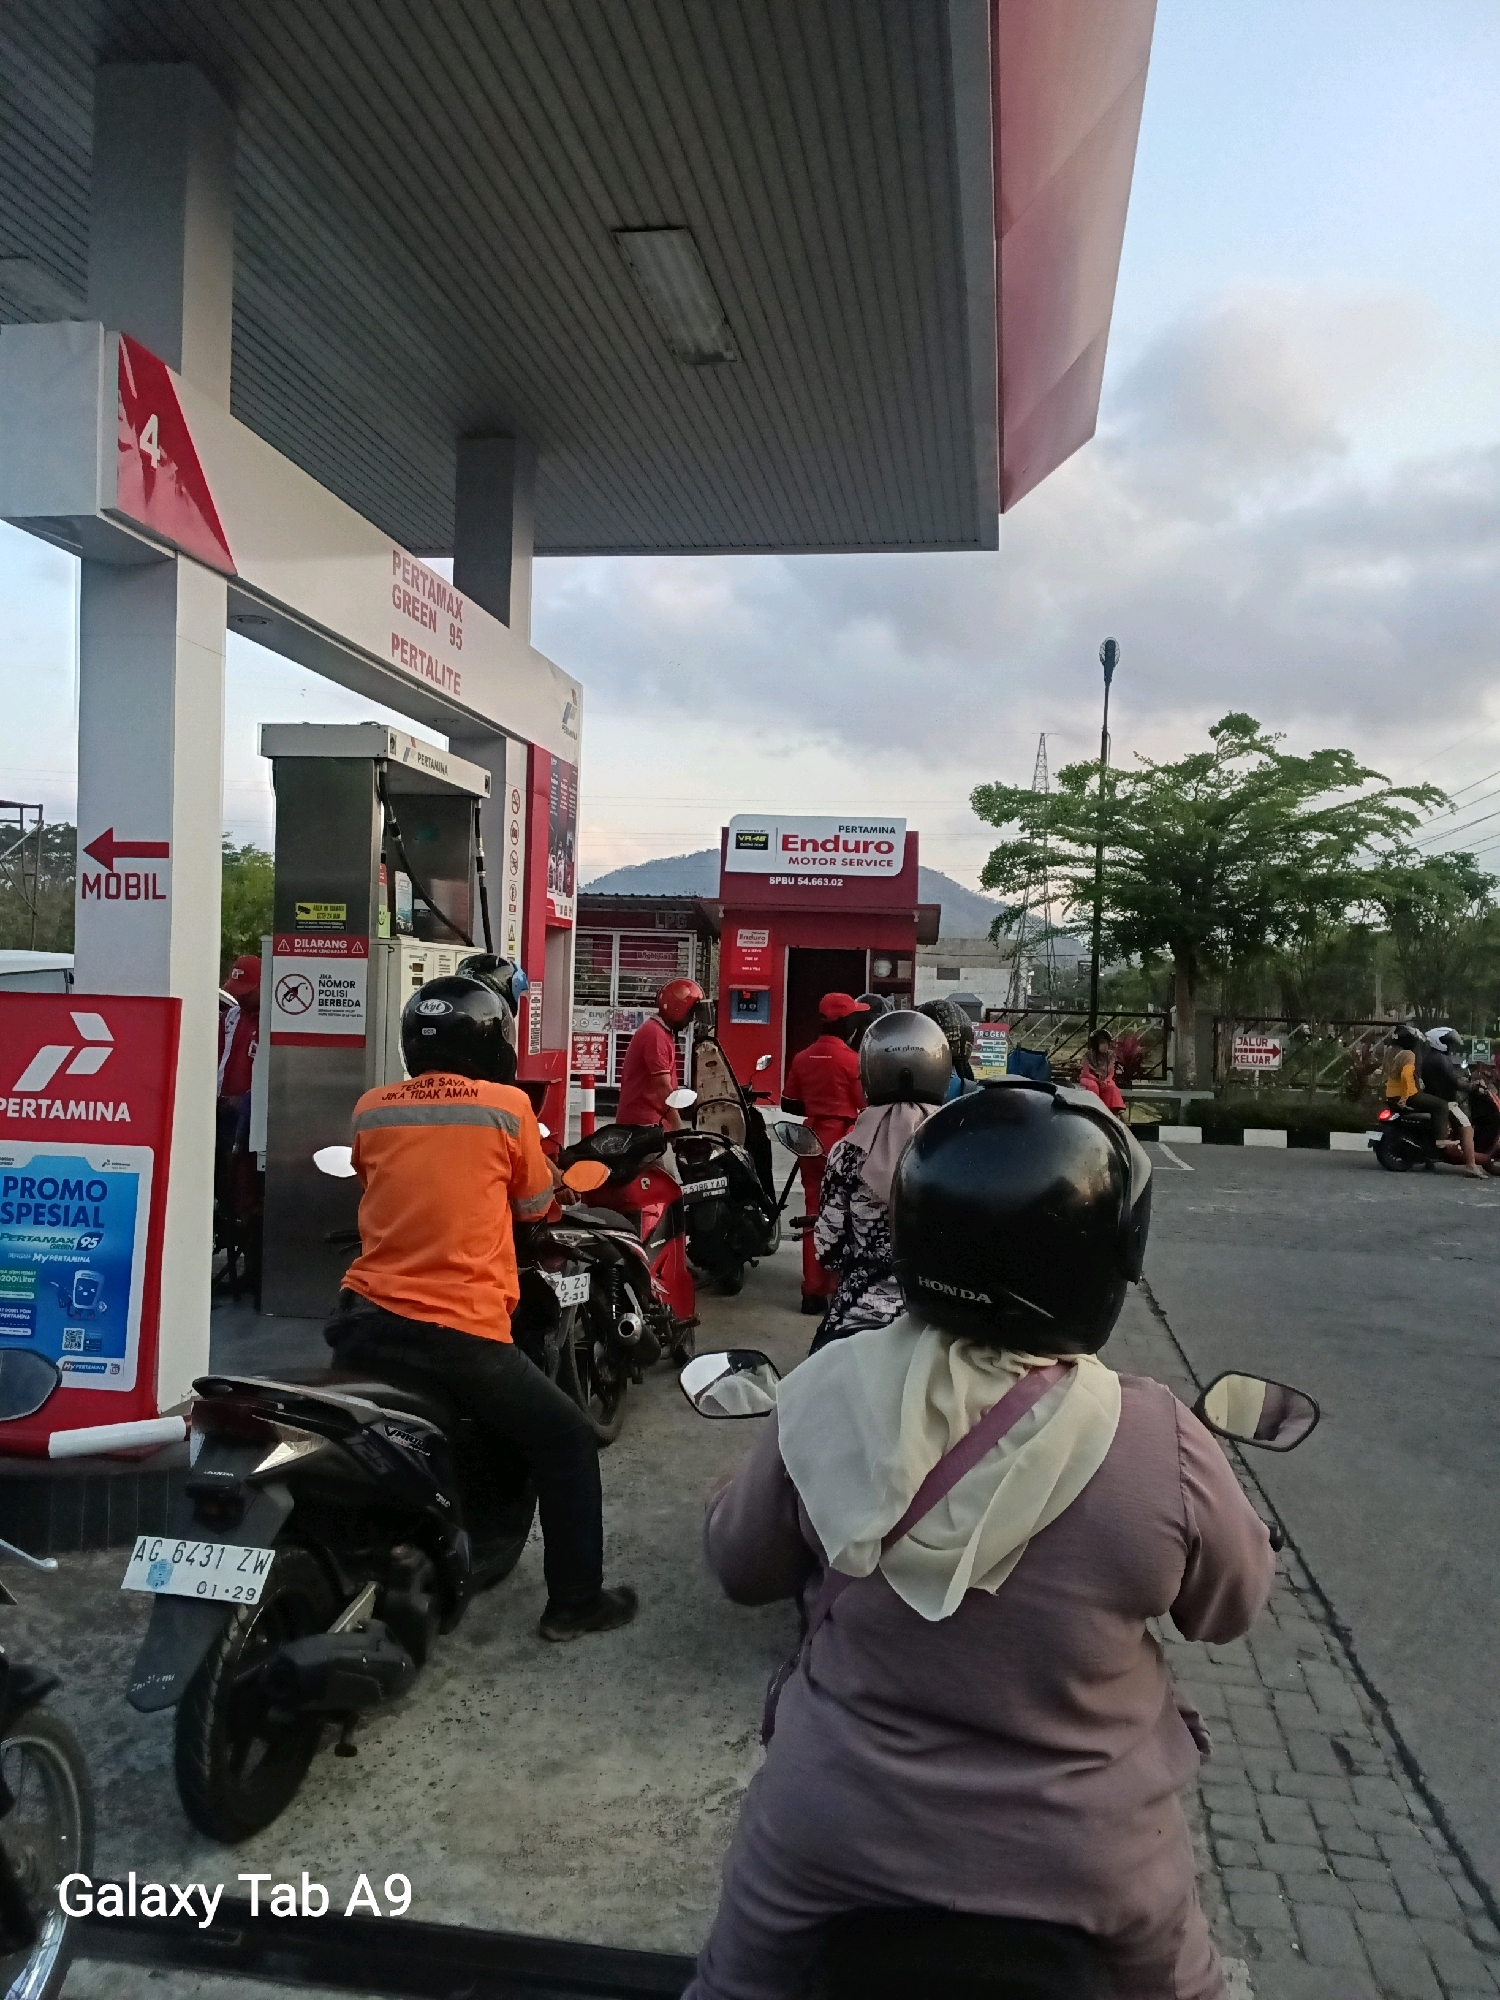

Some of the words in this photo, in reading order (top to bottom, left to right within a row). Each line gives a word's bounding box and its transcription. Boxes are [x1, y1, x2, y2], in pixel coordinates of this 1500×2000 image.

[139, 413, 161, 469] 4
[392, 549, 464, 624] PERTAMAX
[391, 583, 437, 634] GREEN
[449, 622, 463, 651] 95
[391, 631, 462, 697] PERTALITE
[417, 751, 449, 776] PERTAMINA
[838, 825, 896, 834] PERTAMINA
[781, 834, 895, 855] Enduro
[788, 857, 836, 866] MOTOR
[841, 858, 894, 868] SERVICE
[81, 872, 167, 901] MOBIL
[769, 877, 795, 885] SPBU
[797, 877, 844, 887] 54.663.02
[294, 939, 348, 949] DILARANG
[318, 980, 356, 989] NOMOR
[318, 989, 348, 998] POLISI
[318, 998, 361, 1007] BERBEDA
[1236, 1036, 1268, 1047] JALUR
[1233, 1055, 1270, 1065] KELUAR
[400, 1078, 435, 1091] TEGUR
[438, 1077, 466, 1087] SAYA
[381, 1092, 405, 1101] JIKA
[410, 1089, 441, 1099] TIDAK
[444, 1087, 479, 1098] AMAN
[2, 1175, 108, 1203] PROMO
[0, 1201, 105, 1228] SPESIAL
[0, 1232, 77, 1245] PERTAMAX
[80, 1236, 100, 1249] 95
[573, 1275, 588, 1290] ZJ
[918, 1275, 994, 1304] HONDA
[133, 1538, 163, 1562] AG
[171, 1541, 226, 1570] 6431
[236, 1548, 272, 1575] ZW
